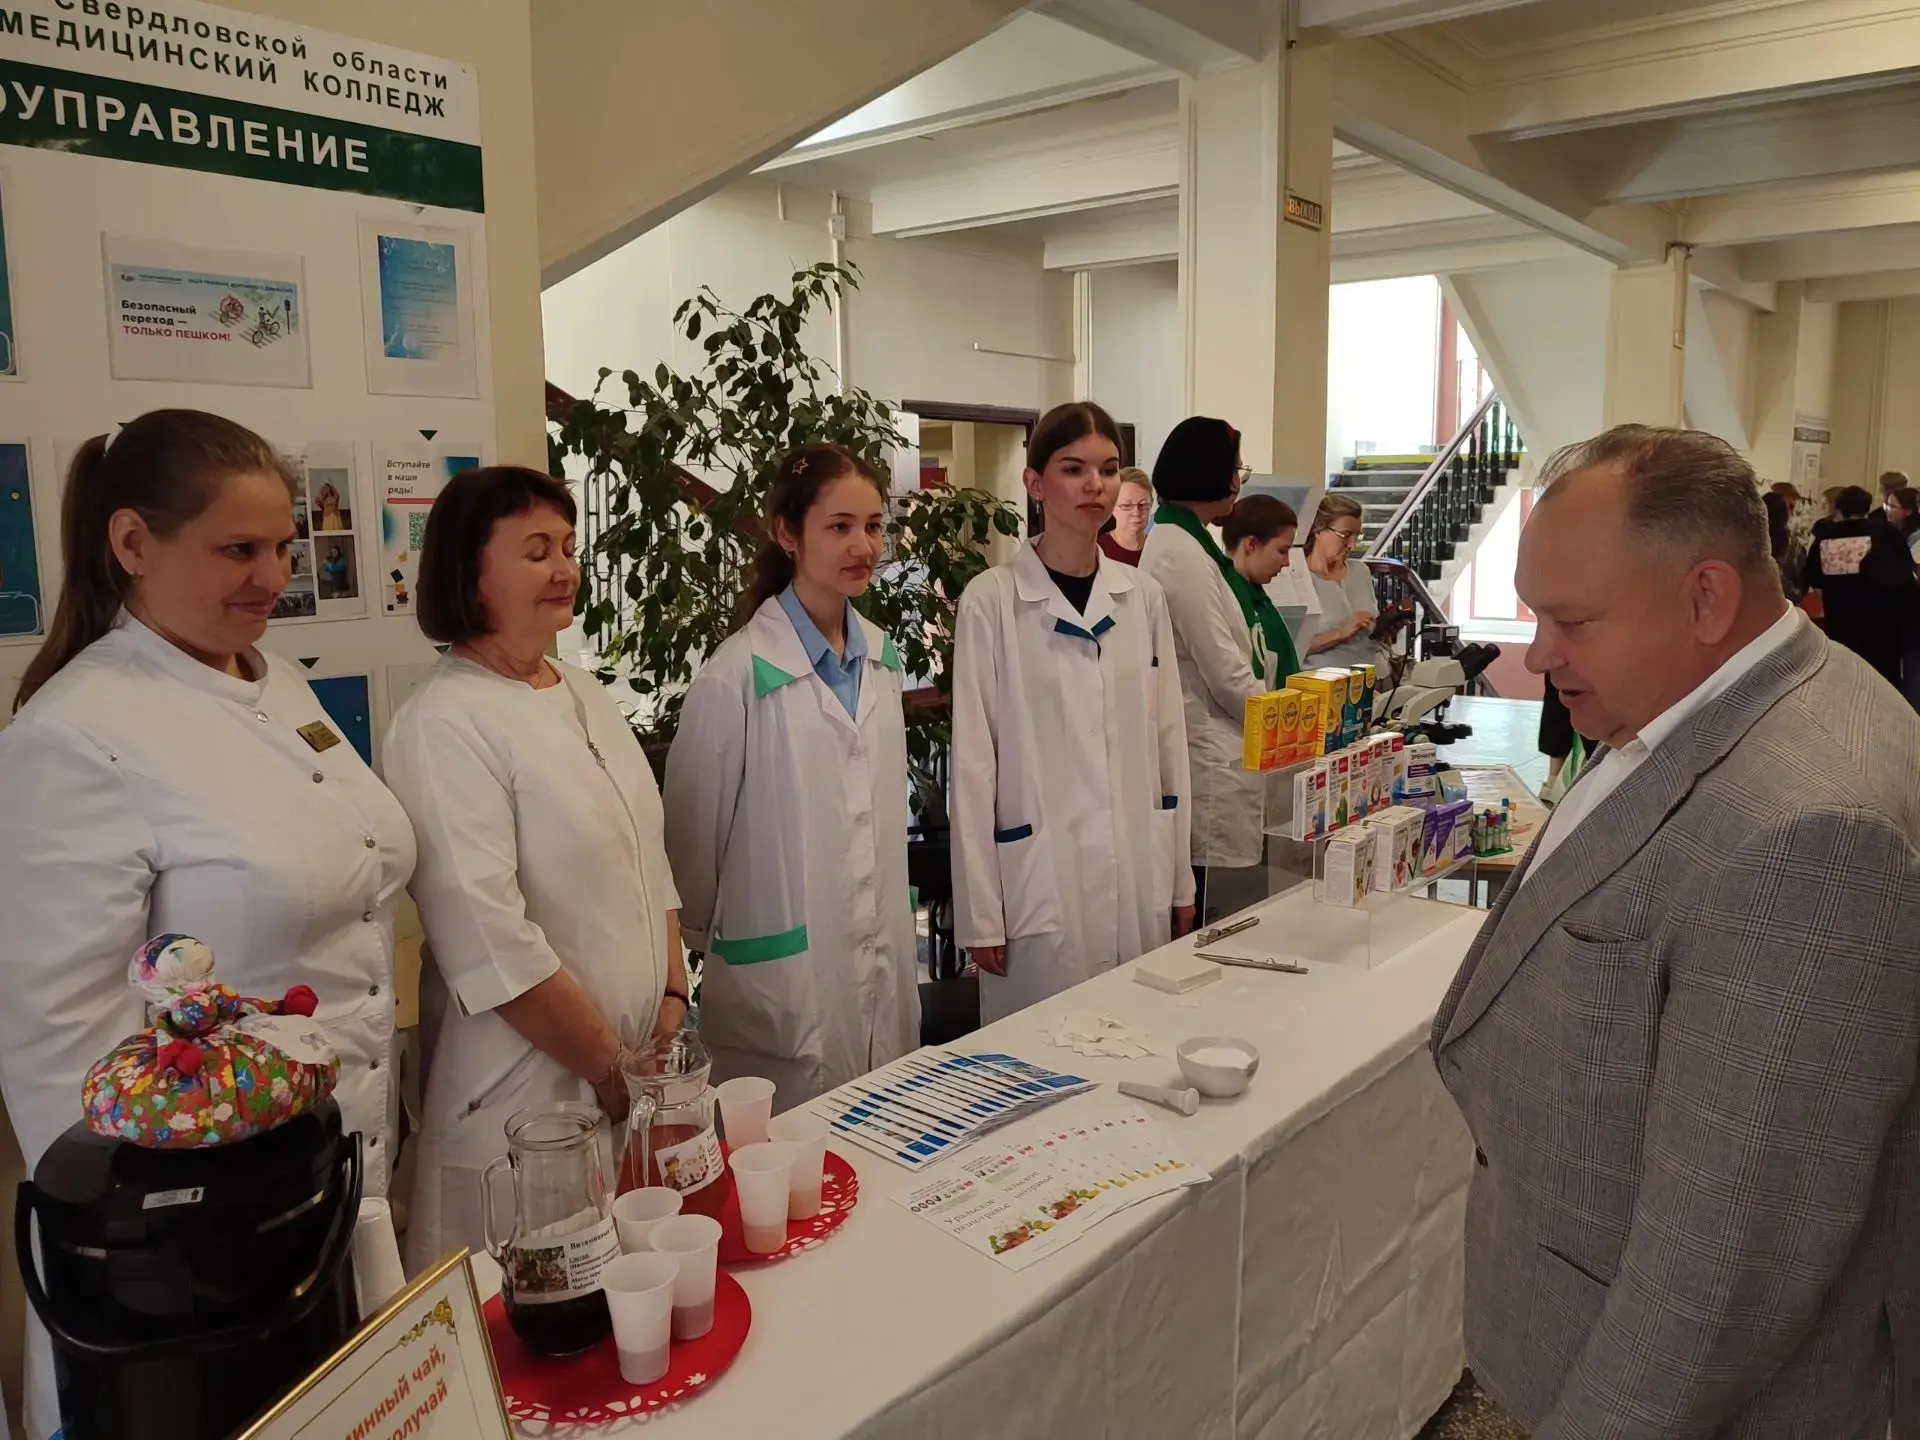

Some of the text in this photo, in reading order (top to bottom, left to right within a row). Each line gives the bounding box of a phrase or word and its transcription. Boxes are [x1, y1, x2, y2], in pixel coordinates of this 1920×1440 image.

[0, 8, 446, 118] МЕДИЦИНСКИЙ КОЛЛЕДЖ
[332, 52, 448, 90] области
[0, 80, 370, 174] УПРАВЛЕНИЕ
[1289, 198, 1320, 224] ВЫХОД
[121, 300, 197, 315] Безопасный
[122, 315, 175, 326] переход
[123, 325, 231, 342] ТОЛЬКО ПЕШКОМ!
[387, 460, 431, 470] Вступайте
[412, 1343, 446, 1382] чай,
[388, 1377, 448, 1440] олучай
